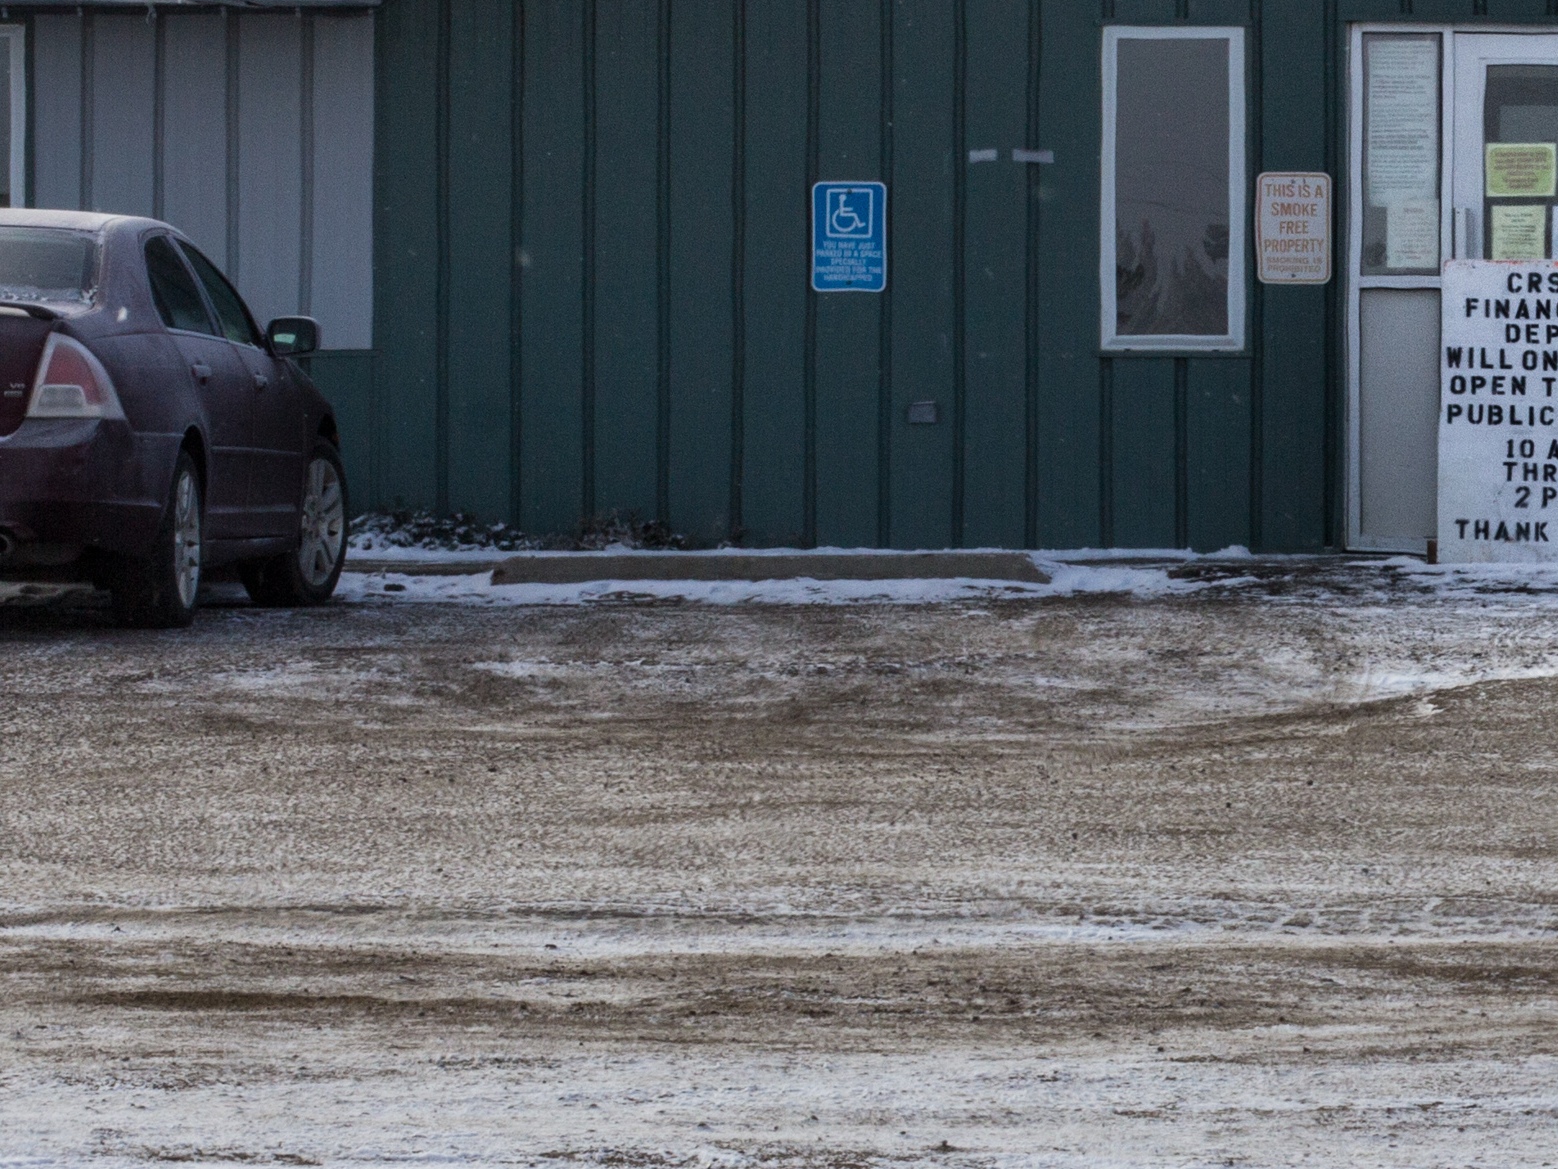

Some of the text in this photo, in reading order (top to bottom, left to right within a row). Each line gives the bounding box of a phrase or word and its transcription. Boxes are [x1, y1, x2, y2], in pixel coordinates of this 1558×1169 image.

[1265, 184, 1324, 199] THIS IS A
[1271, 202, 1318, 217] SMOKE
[1279, 220, 1309, 234] FREE
[1264, 239, 1324, 252] PROPERTY
[1446, 346, 1513, 370] WILL
[1450, 375, 1527, 395] OPEN
[1447, 403, 1554, 426] PUBLIC
[1506, 439, 1536, 459] 10
[1514, 485, 1531, 508] 2
[1454, 518, 1550, 542] THANK
